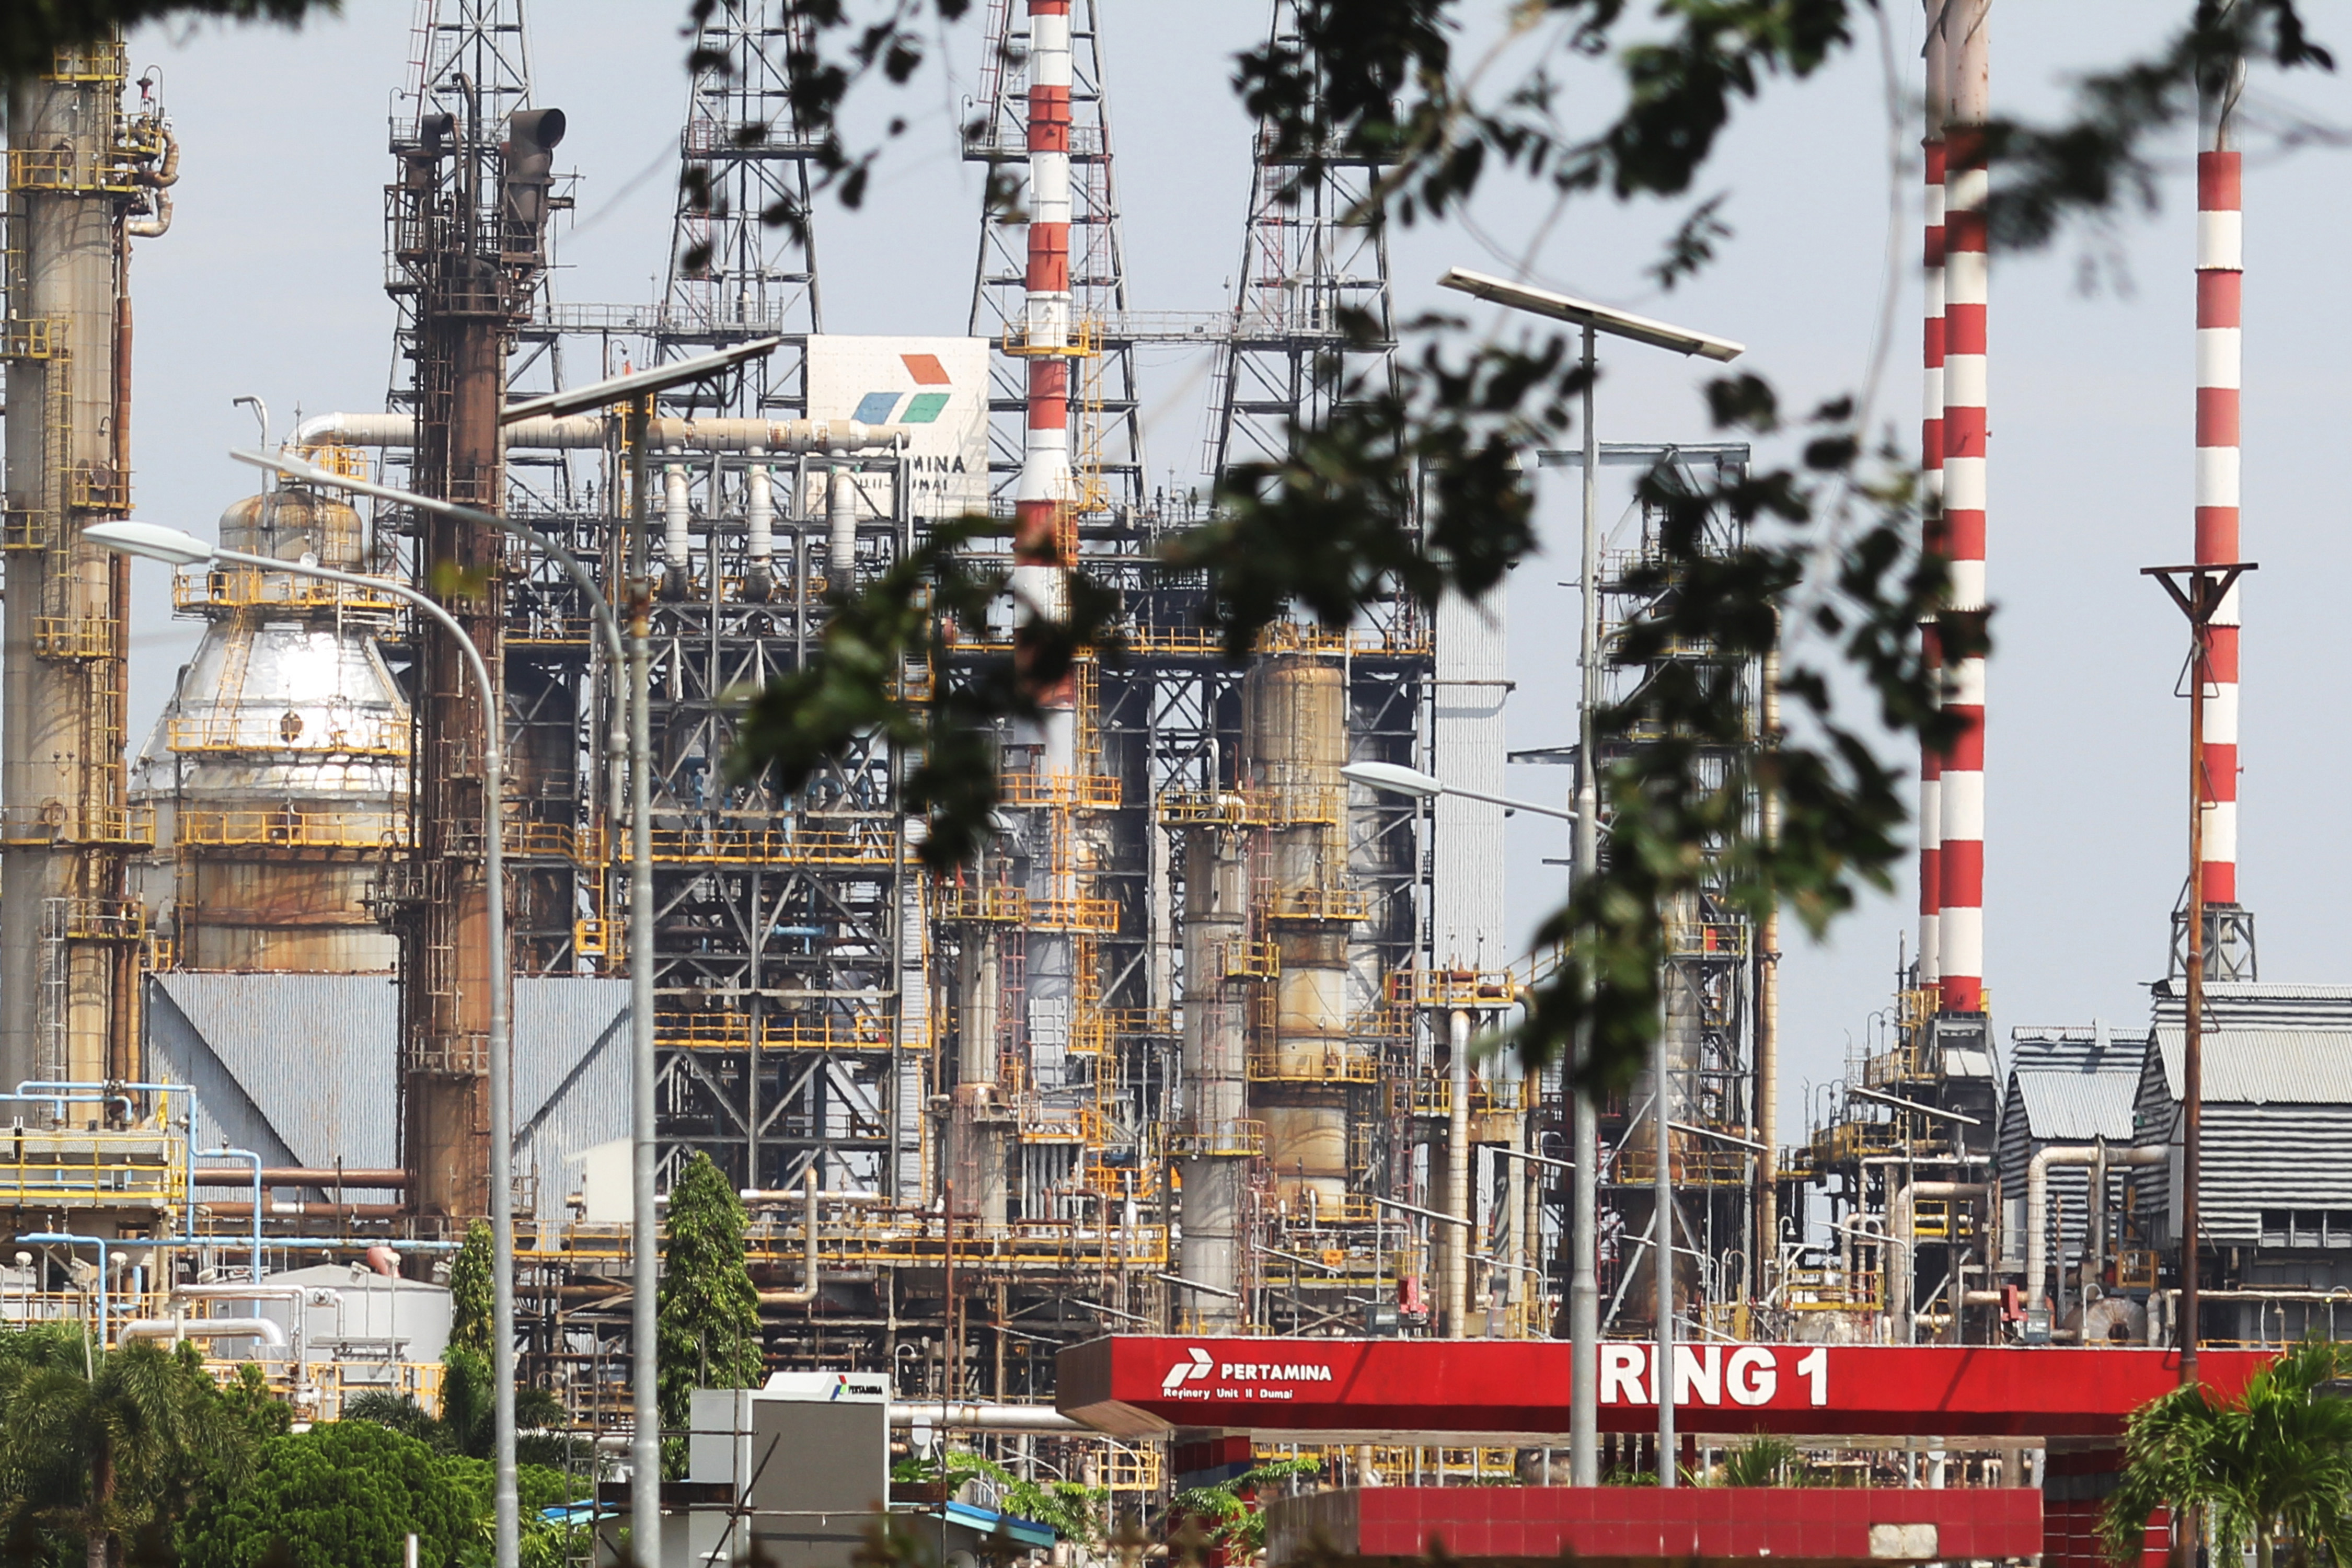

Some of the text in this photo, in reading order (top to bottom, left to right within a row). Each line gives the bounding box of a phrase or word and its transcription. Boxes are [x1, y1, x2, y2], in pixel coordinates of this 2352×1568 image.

[914, 455, 966, 473] MINA
[1221, 1363, 1332, 1381] PERTAMINA
[1600, 1345, 1828, 1406] RING 1
[1163, 1388, 1210, 1400] Refinery
[1217, 1388, 1238, 1398] Unit
[1260, 1389, 1293, 1399] Dumai
